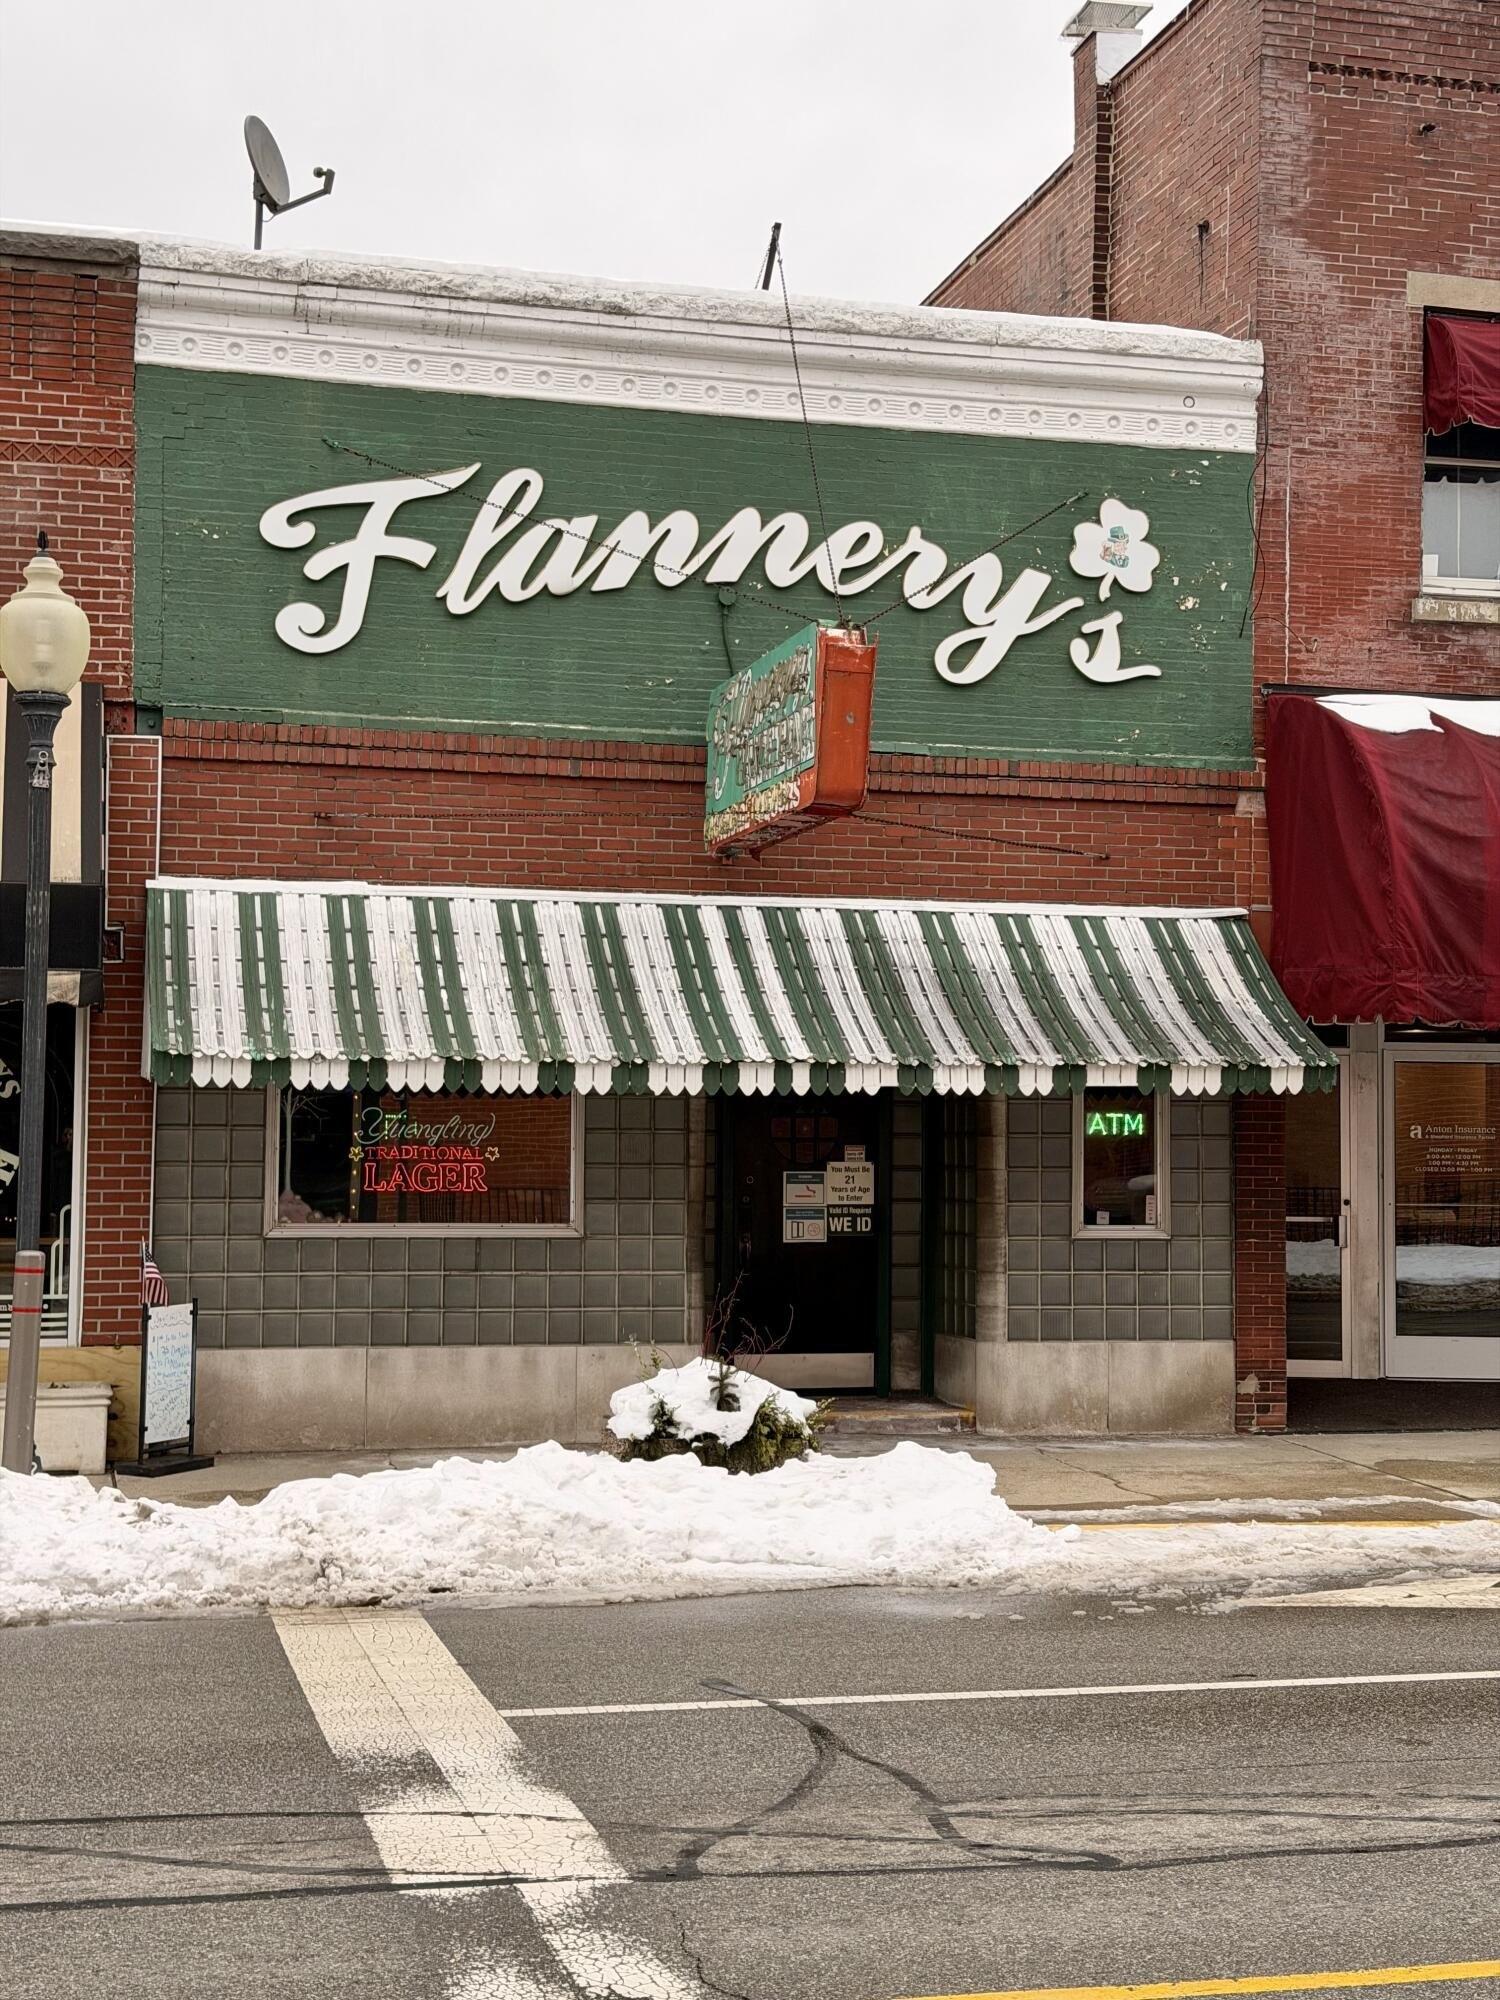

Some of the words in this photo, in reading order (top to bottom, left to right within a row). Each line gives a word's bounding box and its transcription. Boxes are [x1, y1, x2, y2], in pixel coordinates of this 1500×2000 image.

[356, 1107, 495, 1146] Yuengling
[1088, 1112, 1144, 1136] ATM
[1425, 1124, 1453, 1133] Anton
[1455, 1124, 1497, 1134] Insurance
[365, 1146, 484, 1160] TRADITIONAL
[831, 1165, 843, 1173] You
[844, 1165, 860, 1173] Must
[861, 1165, 871, 1173] Be
[363, 1162, 488, 1192] LAGER
[844, 1175, 855, 1185] 21
[831, 1185, 848, 1193] Years
[849, 1185, 857, 1193] of
[858, 1185, 871, 1195] Age
[829, 1216, 852, 1232] WE
[856, 1216, 872, 1232] ID
